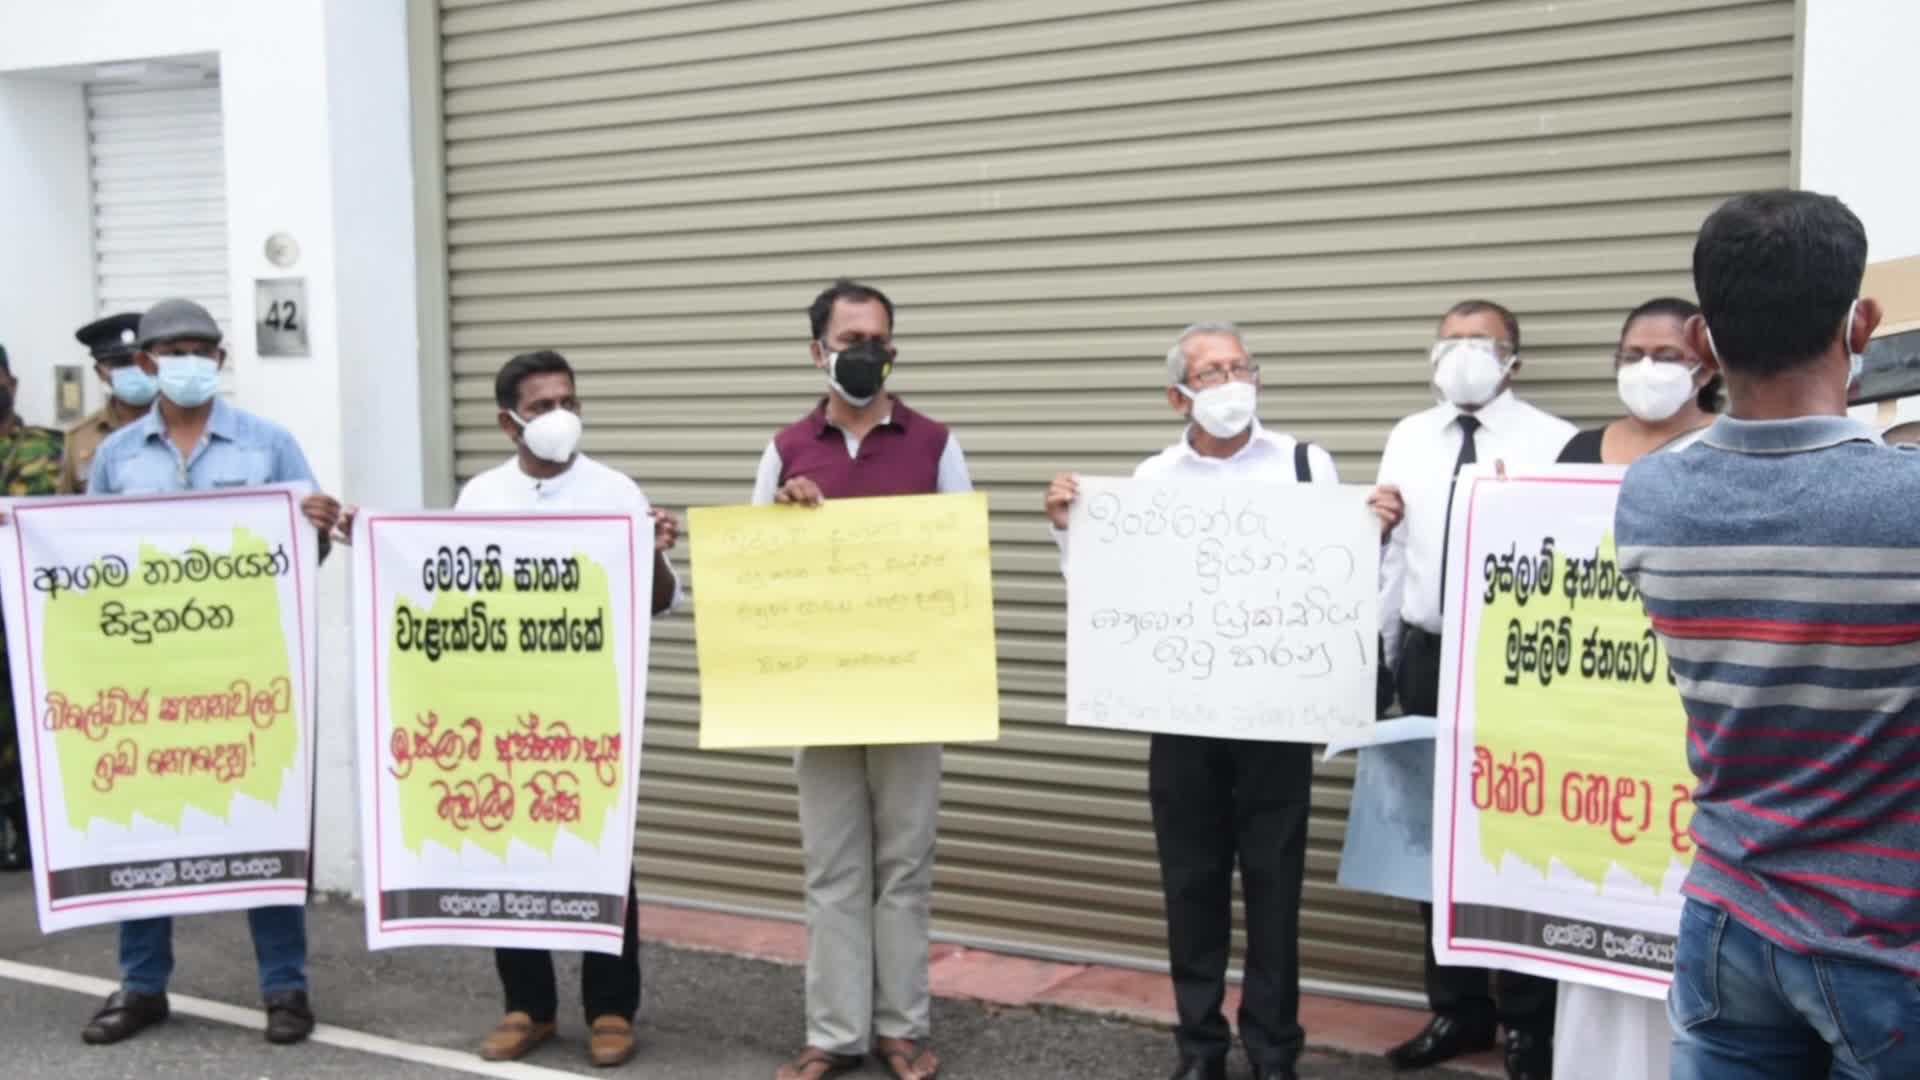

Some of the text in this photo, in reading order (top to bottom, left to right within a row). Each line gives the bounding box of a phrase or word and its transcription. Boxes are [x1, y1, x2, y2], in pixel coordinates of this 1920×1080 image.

[264, 299, 298, 332] 42
[33, 544, 291, 600] ආගම නාමයෙන්
[422, 544, 580, 592] මෙවැනි ඝාතන
[1483, 537, 1555, 606] ඉස්ලාම්
[100, 600, 235, 645] සිදුකරන
[396, 601, 605, 661] වැළැක්විය හැක්කේ
[1504, 616, 1573, 686] මුස්ලිම්
[1580, 626, 1658, 684] ජනයාට
[92, 738, 139, 792] ඉඩ
[388, 711, 483, 780] ඉස්ලාම්
[1561, 771, 1653, 845] හෙළා
